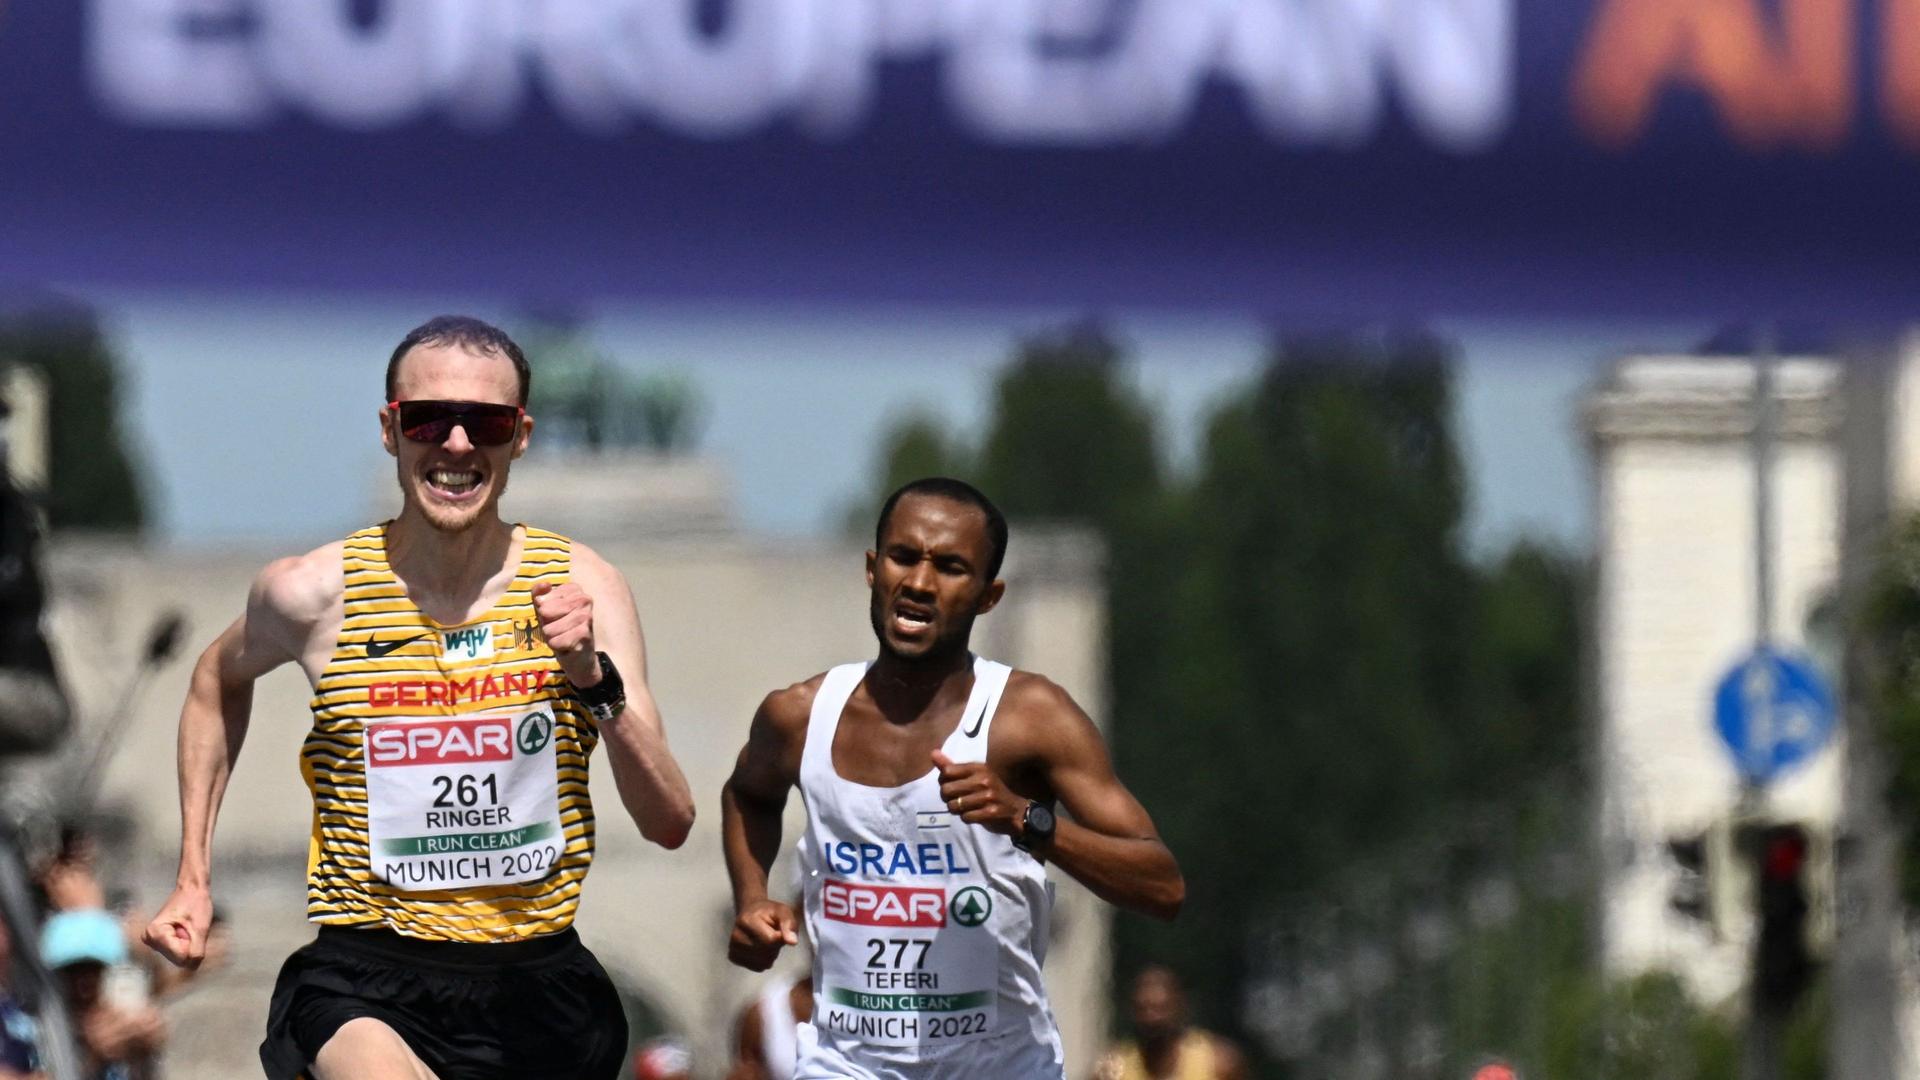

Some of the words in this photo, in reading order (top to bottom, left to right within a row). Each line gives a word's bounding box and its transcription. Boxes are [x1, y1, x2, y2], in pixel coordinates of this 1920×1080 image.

[368, 669, 552, 708] GERMANY
[372, 726, 510, 763] SPAR
[431, 773, 499, 808] 261
[426, 806, 512, 829] RINGER
[425, 835, 465, 852] RUN
[825, 842, 970, 876] ISRAEL
[385, 857, 491, 884] MUNICH
[501, 845, 557, 877] 2022
[824, 884, 943, 923] SPAR
[866, 938, 932, 969] 277
[863, 972, 939, 989] TEFERI
[861, 995, 893, 1009] RUN
[828, 1010, 918, 1039] MUNICH
[928, 1012, 987, 1039] 2022
